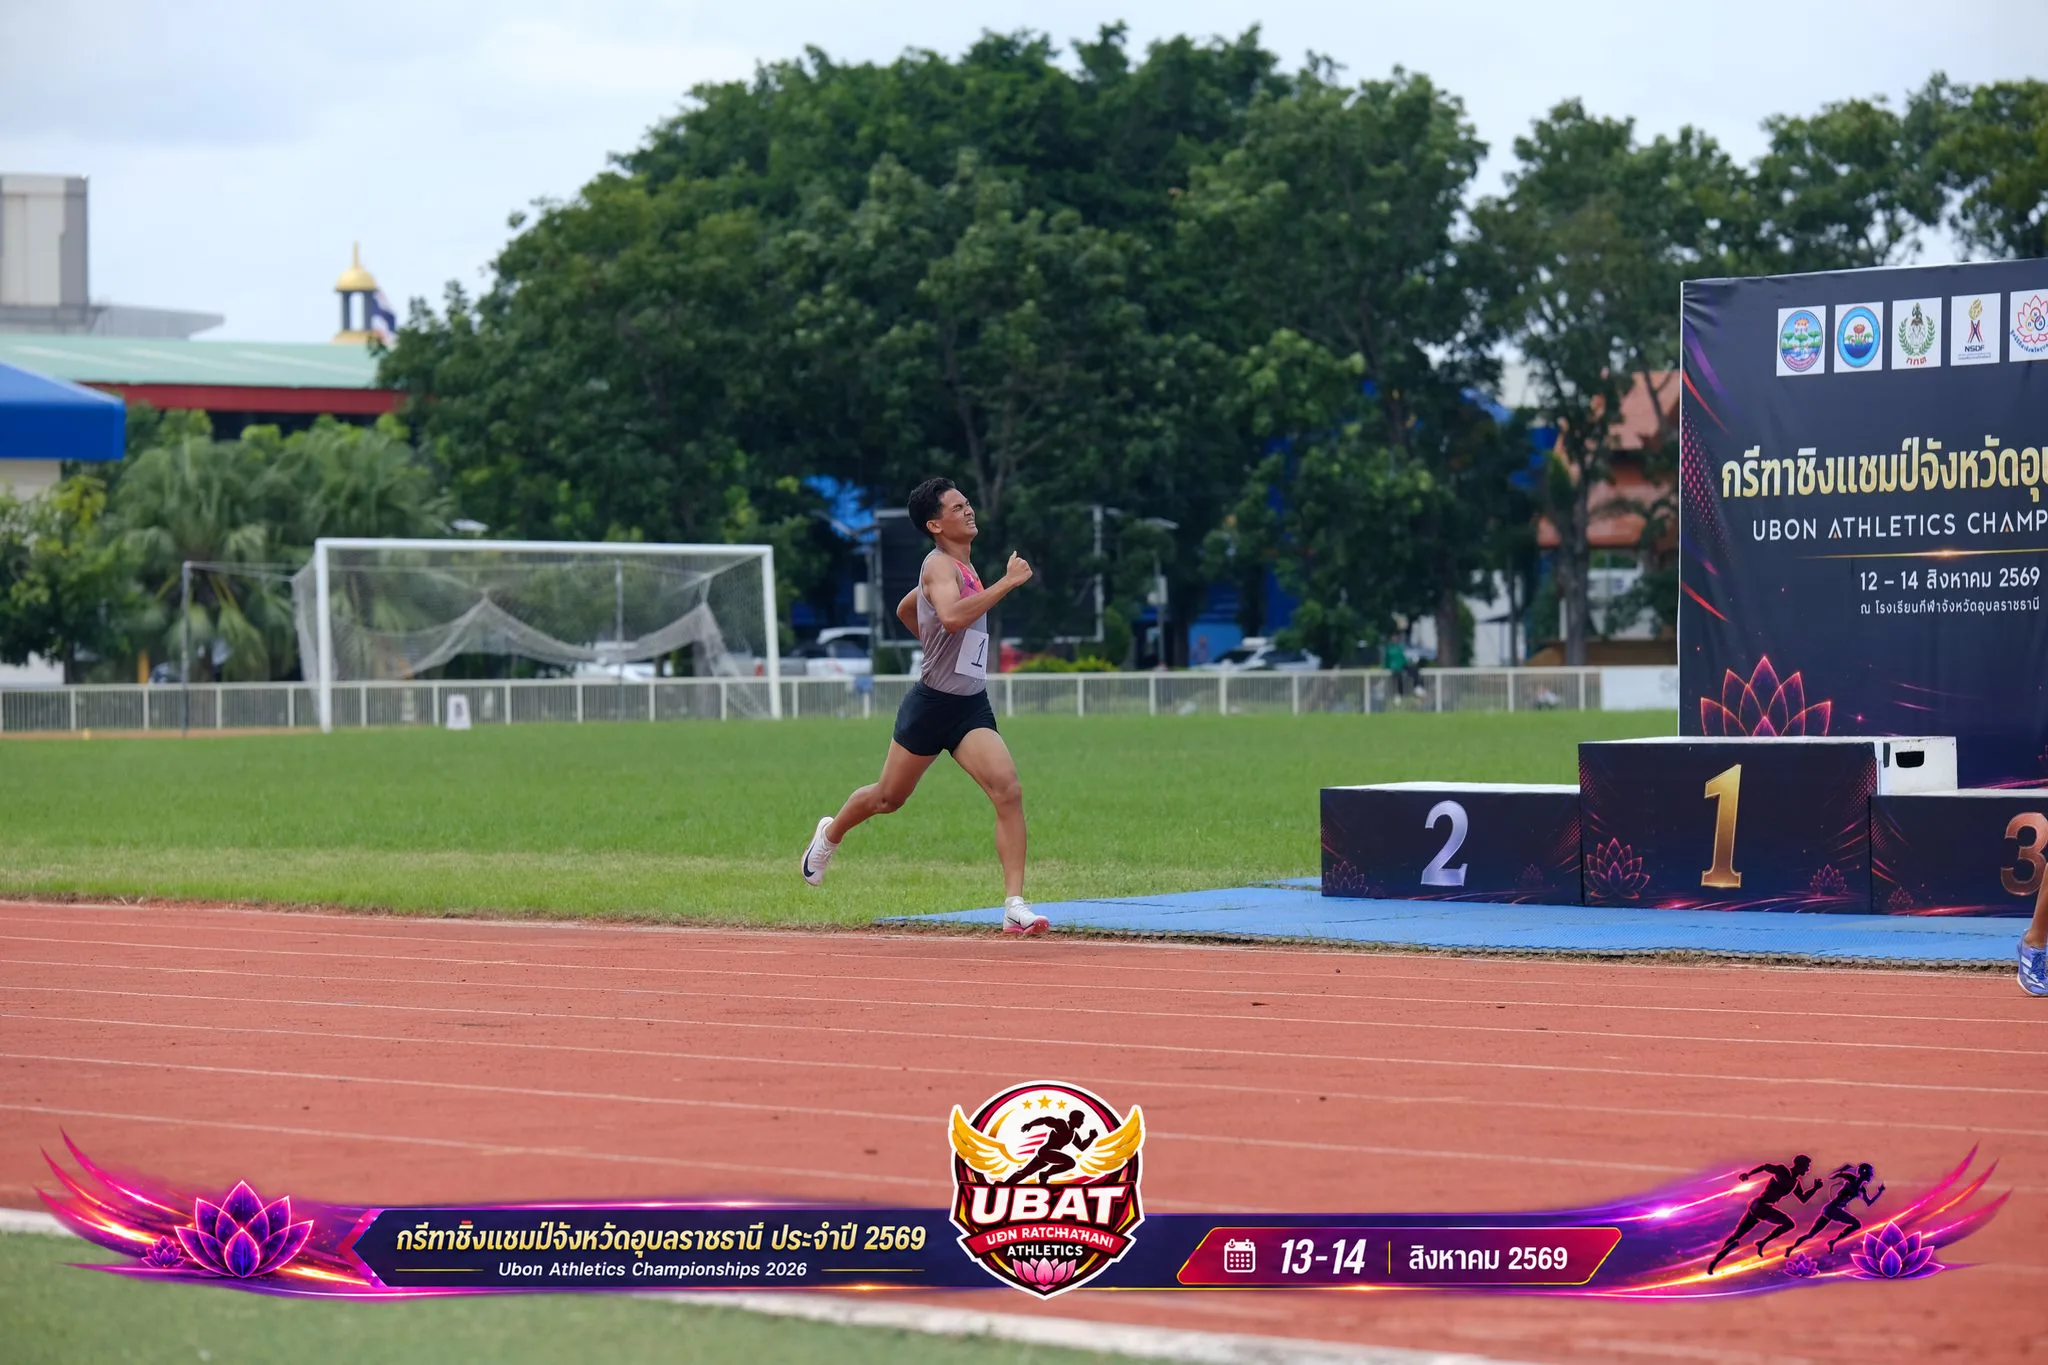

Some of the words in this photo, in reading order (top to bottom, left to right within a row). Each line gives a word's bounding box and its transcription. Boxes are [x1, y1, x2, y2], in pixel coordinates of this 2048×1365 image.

[1753, 518, 1816, 541] UBON
[1828, 513, 1956, 540] ATHLETICS
[1860, 571, 1878, 591] 12
[1901, 570, 1919, 590] 14
[1926, 568, 1992, 590] สิงหาคม
[1999, 566, 2041, 588] 2569
[970, 638, 986, 668] 1
[1421, 800, 1469, 886] 2
[1701, 763, 1742, 888] 1
[2000, 812, 2048, 896] 3
